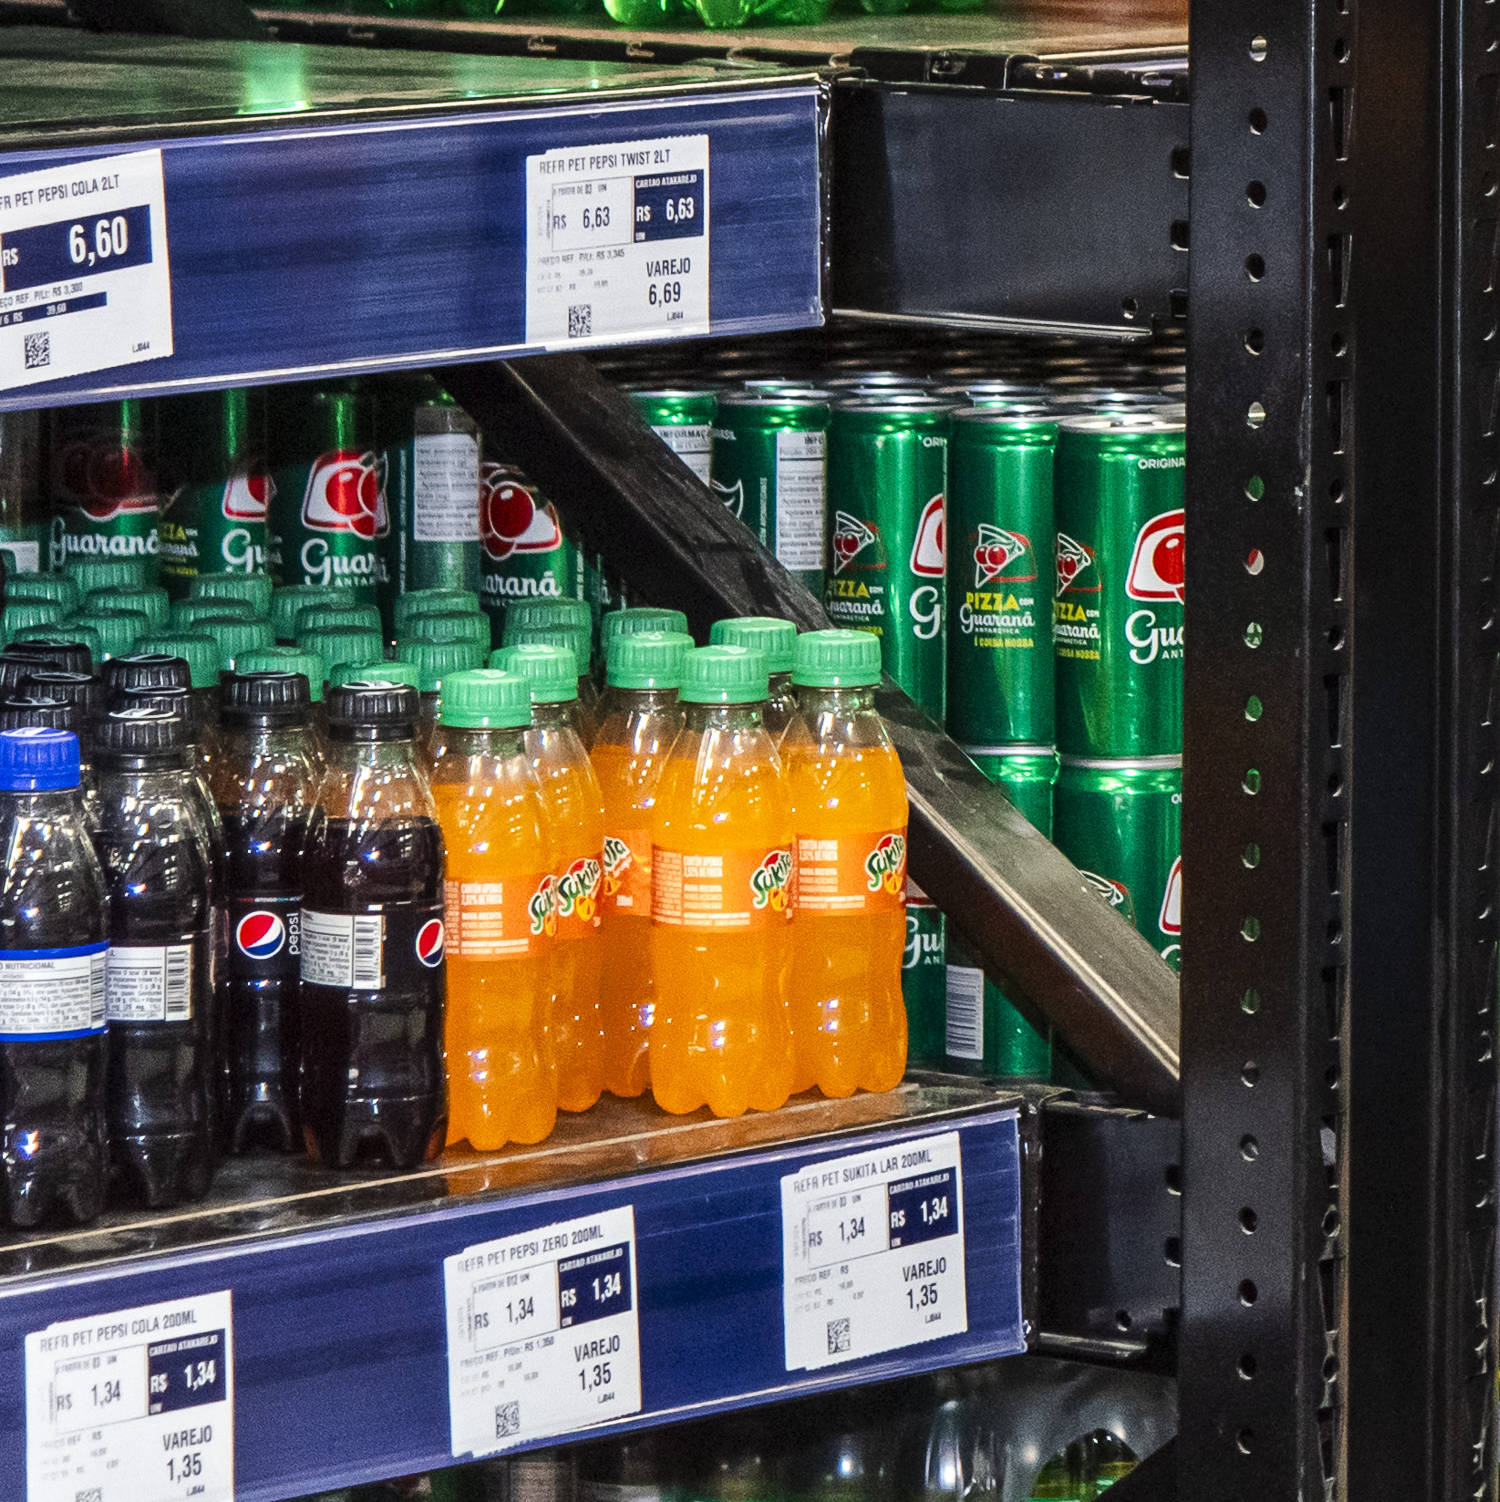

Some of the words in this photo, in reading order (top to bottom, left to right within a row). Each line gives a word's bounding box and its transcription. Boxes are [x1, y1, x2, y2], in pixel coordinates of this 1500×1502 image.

[539, 159, 566, 174] REFR
[568, 156, 586, 172] PET
[589, 154, 618, 170] PEPSI
[621, 151, 651, 168] TWIST
[653, 149, 671, 164] 2LT
[15, 190, 34, 208] PET
[38, 184, 68, 203] PEPSI
[72, 179, 99, 197] COLA
[101, 174, 120, 191] 2LT
[553, 214, 567, 230] R$
[583, 205, 611, 230] 6,63
[636, 205, 651, 222] R$
[666, 197, 695, 224] 6,63
[2, 247, 19, 267] R$
[68, 215, 128, 267] 6,60
[645, 257, 691, 278] VAREJO
[648, 281, 682, 307] 6,69
[965, 591, 1020, 611] PIZZA
[959, 602, 1036, 634] Guaraná
[559, 859, 600, 914] Sukita
[793, 1173, 820, 1194] REFR
[821, 1167, 840, 1186] PET
[842, 1160, 878, 1184] SUKITA
[879, 1155, 900, 1178] LAR
[901, 1148, 933, 1171] 200ML
[890, 1209, 906, 1230] R$
[920, 1195, 949, 1225] 1,34
[487, 1249, 506, 1268] PET
[510, 1241, 539, 1262] PEPSI
[542, 1235, 569, 1255] ZERO
[571, 1224, 604, 1246] 200ML
[808, 1230, 824, 1248] R$
[838, 1216, 866, 1245] 1,34
[902, 1257, 947, 1283] VAREJO
[561, 1288, 577, 1308] R$
[592, 1271, 622, 1304] 1,34
[906, 1282, 939, 1311] 1,35
[72, 1328, 94, 1347] PET
[97, 1322, 129, 1343] PEPSI
[131, 1317, 160, 1336] COLA
[162, 1308, 198, 1330] 200ML
[474, 1312, 490, 1330] R$
[505, 1296, 535, 1326] 1,34
[574, 1334, 621, 1363] VAREJO
[150, 1373, 168, 1394] R$
[184, 1359, 216, 1392] 1,34
[578, 1361, 612, 1393] 1,35
[56, 1393, 73, 1411] R$
[91, 1379, 122, 1410] 1,34
[162, 1424, 213, 1452] VAREJO
[166, 1452, 202, 1484] 1,35
